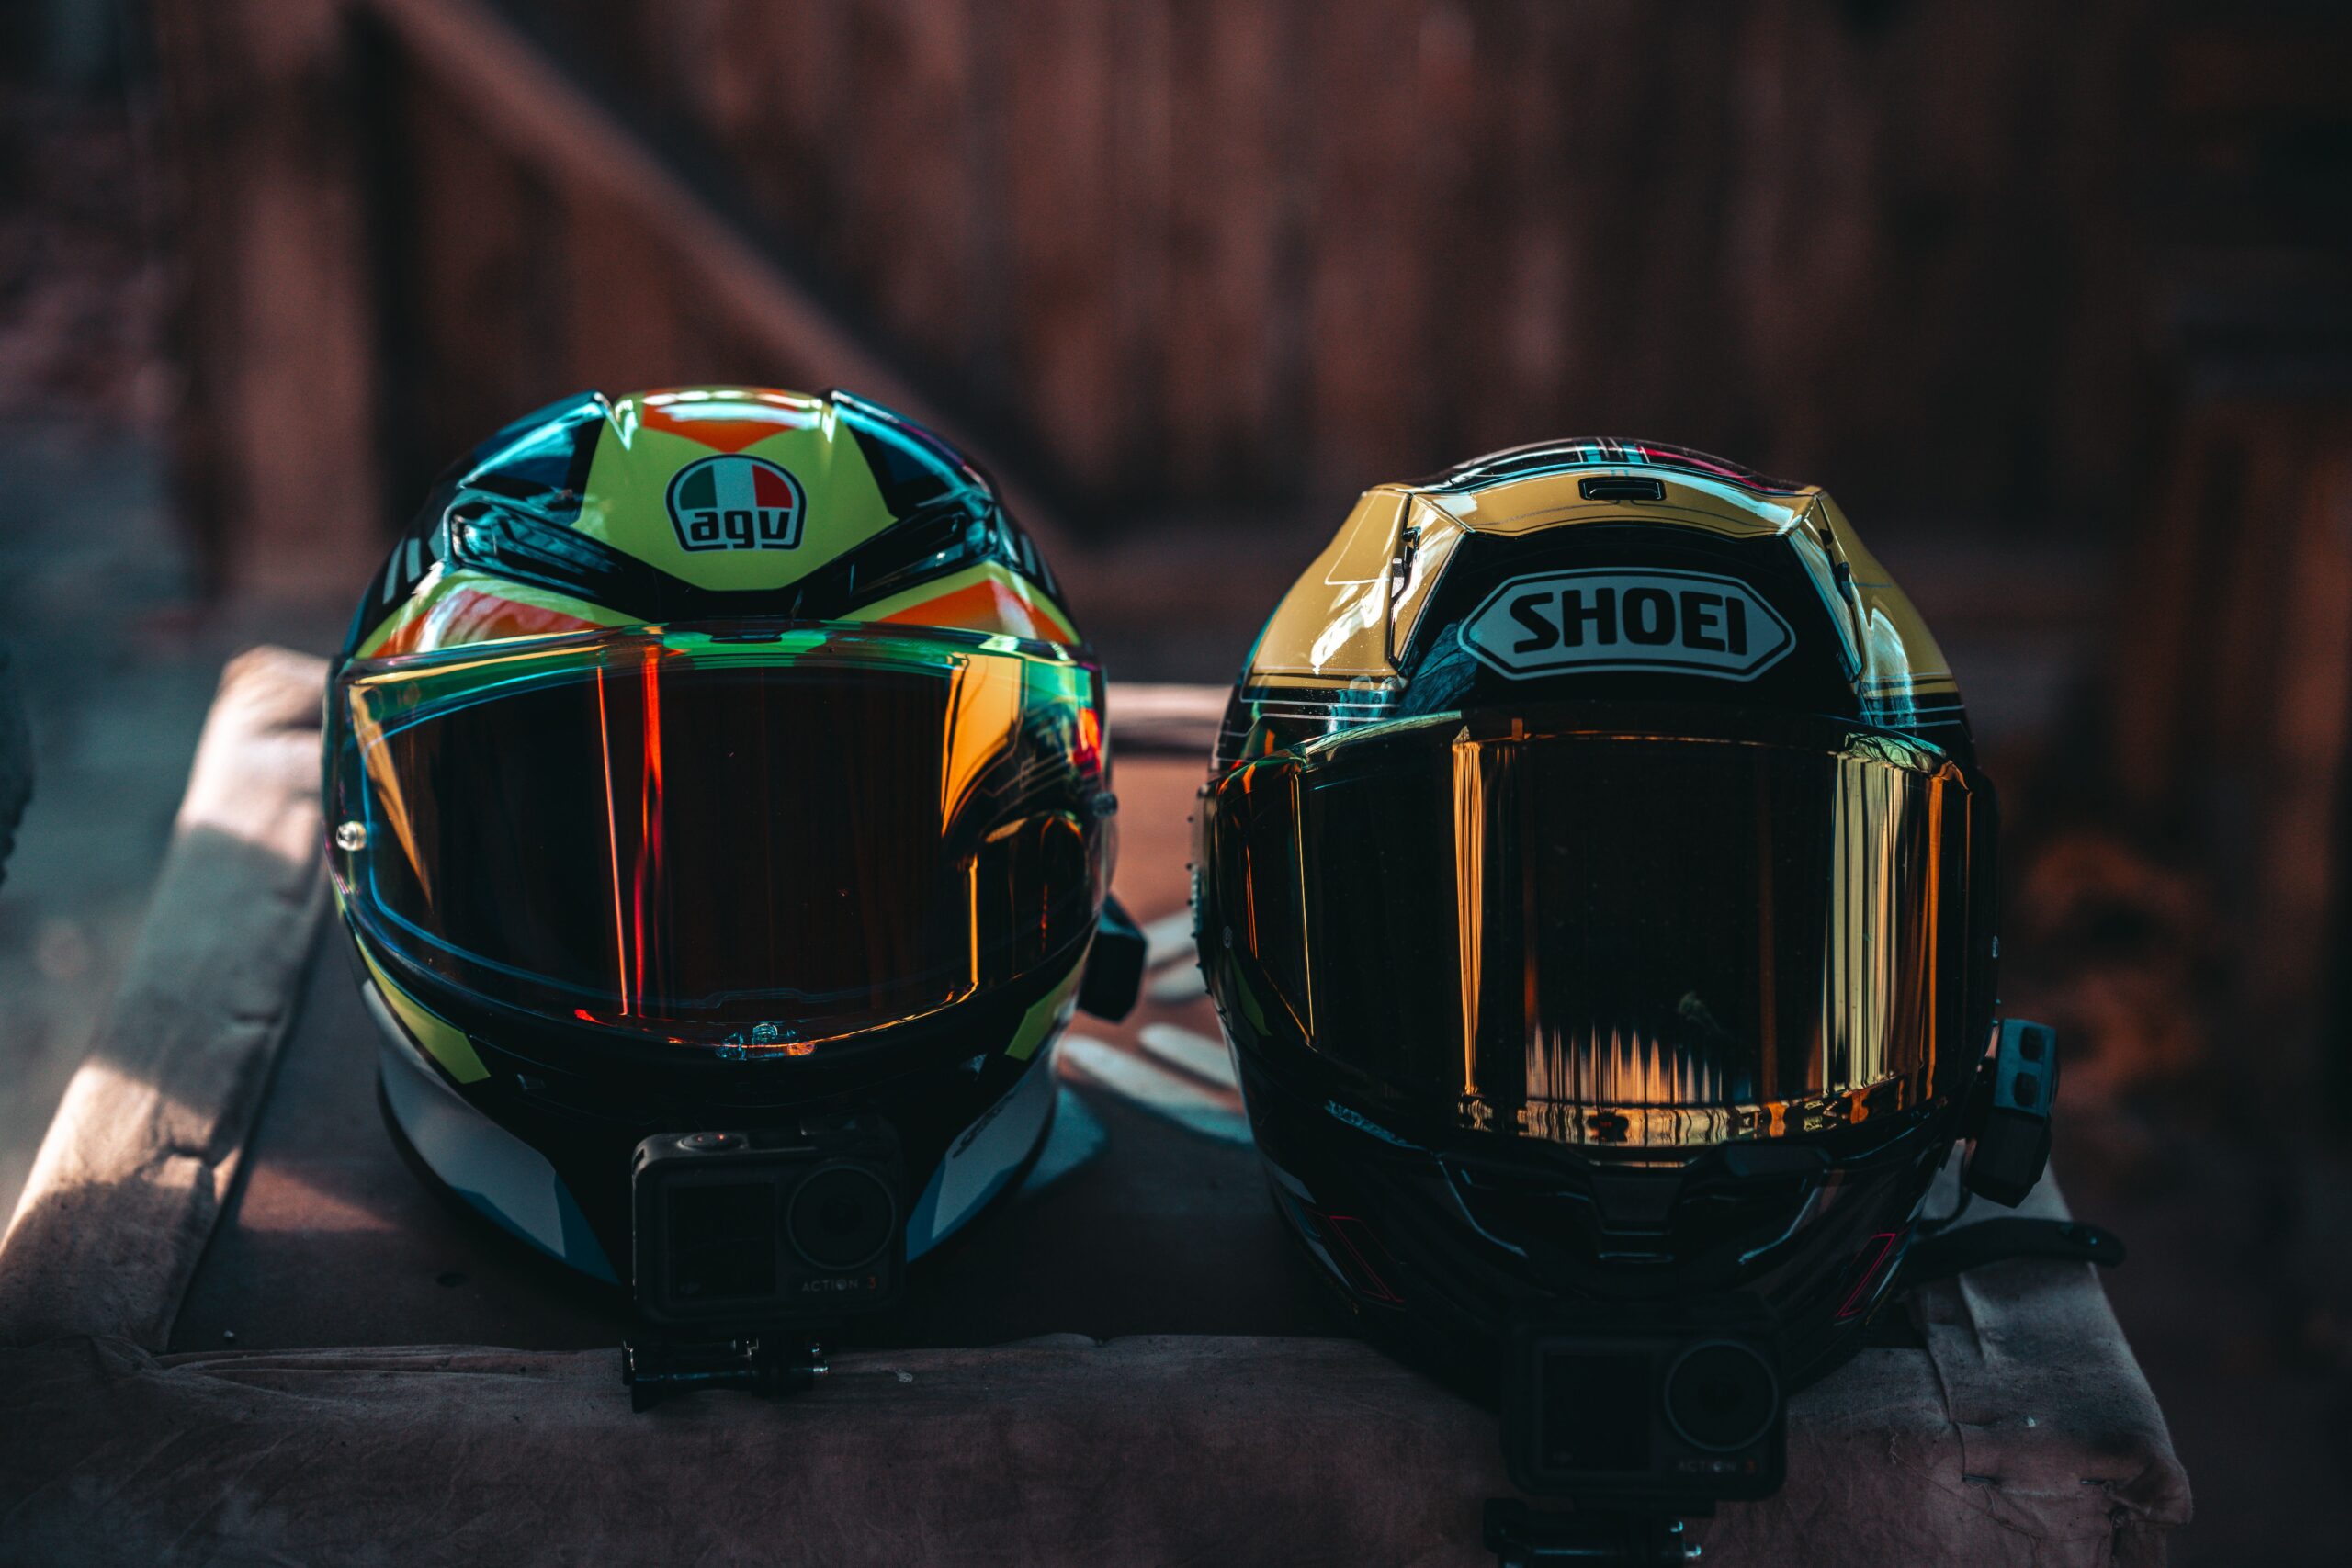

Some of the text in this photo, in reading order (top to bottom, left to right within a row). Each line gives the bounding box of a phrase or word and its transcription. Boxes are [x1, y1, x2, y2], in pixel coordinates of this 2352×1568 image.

[690, 511, 790, 549] agv
[1510, 587, 1747, 656] SHOEI
[801, 1278, 859, 1292] ACTION
[1677, 1459, 1736, 1472] ACTON
